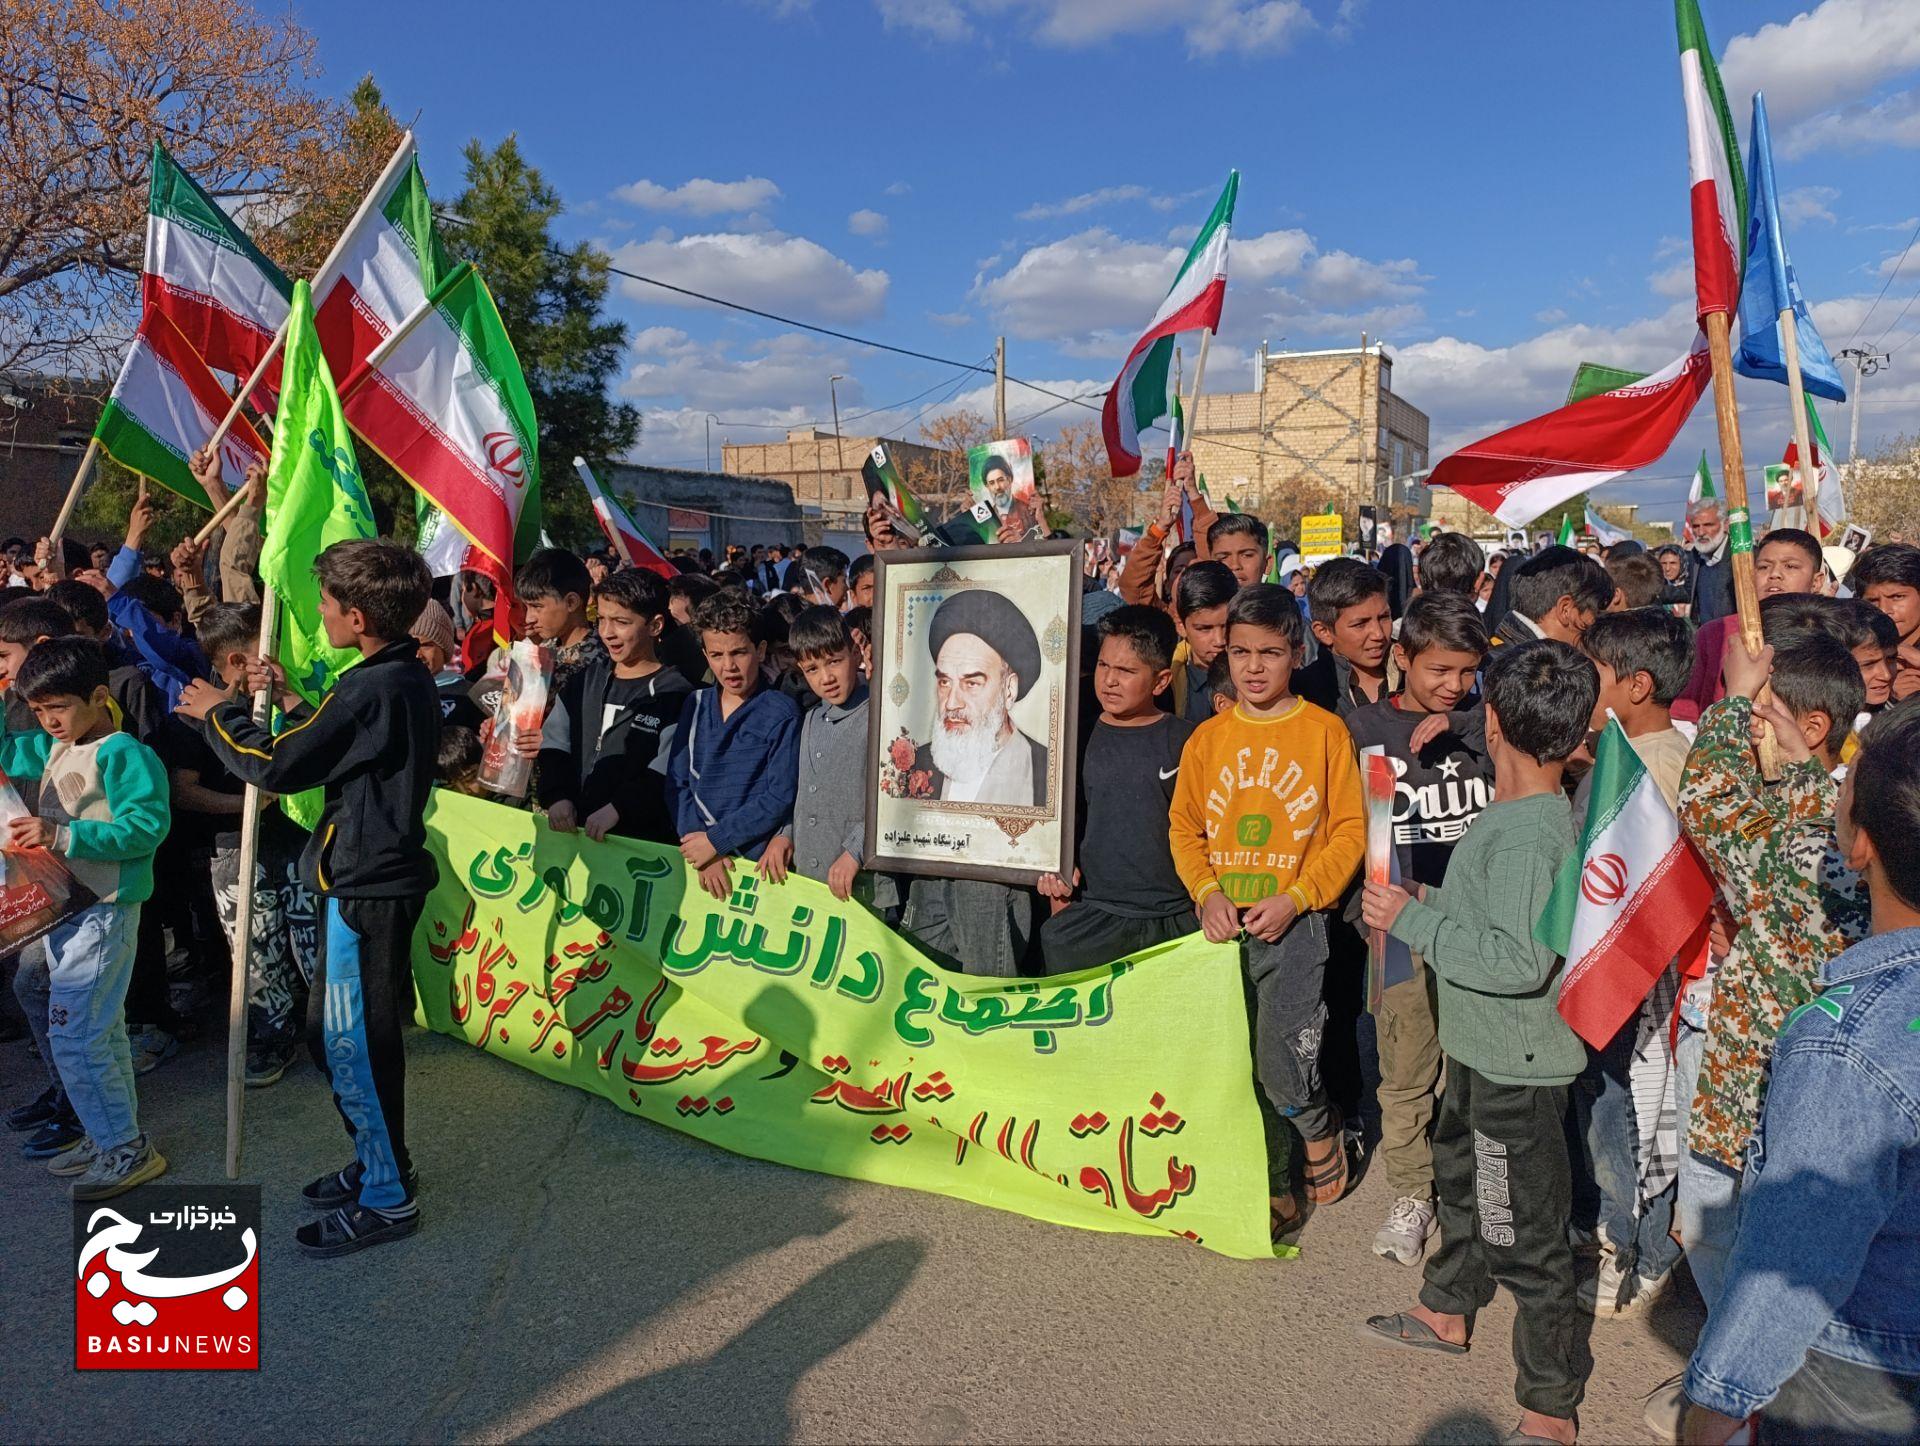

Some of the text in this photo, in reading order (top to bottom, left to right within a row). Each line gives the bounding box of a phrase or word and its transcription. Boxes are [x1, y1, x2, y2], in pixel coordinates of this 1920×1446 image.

[912, 832, 932, 848] شهید
[932, 832, 971, 851] آموزشگاه
[469, 842, 1133, 1054] اجتماع دانش آموزی
[622, 1035, 762, 1117] بیعت
[758, 1048, 800, 1082] و
